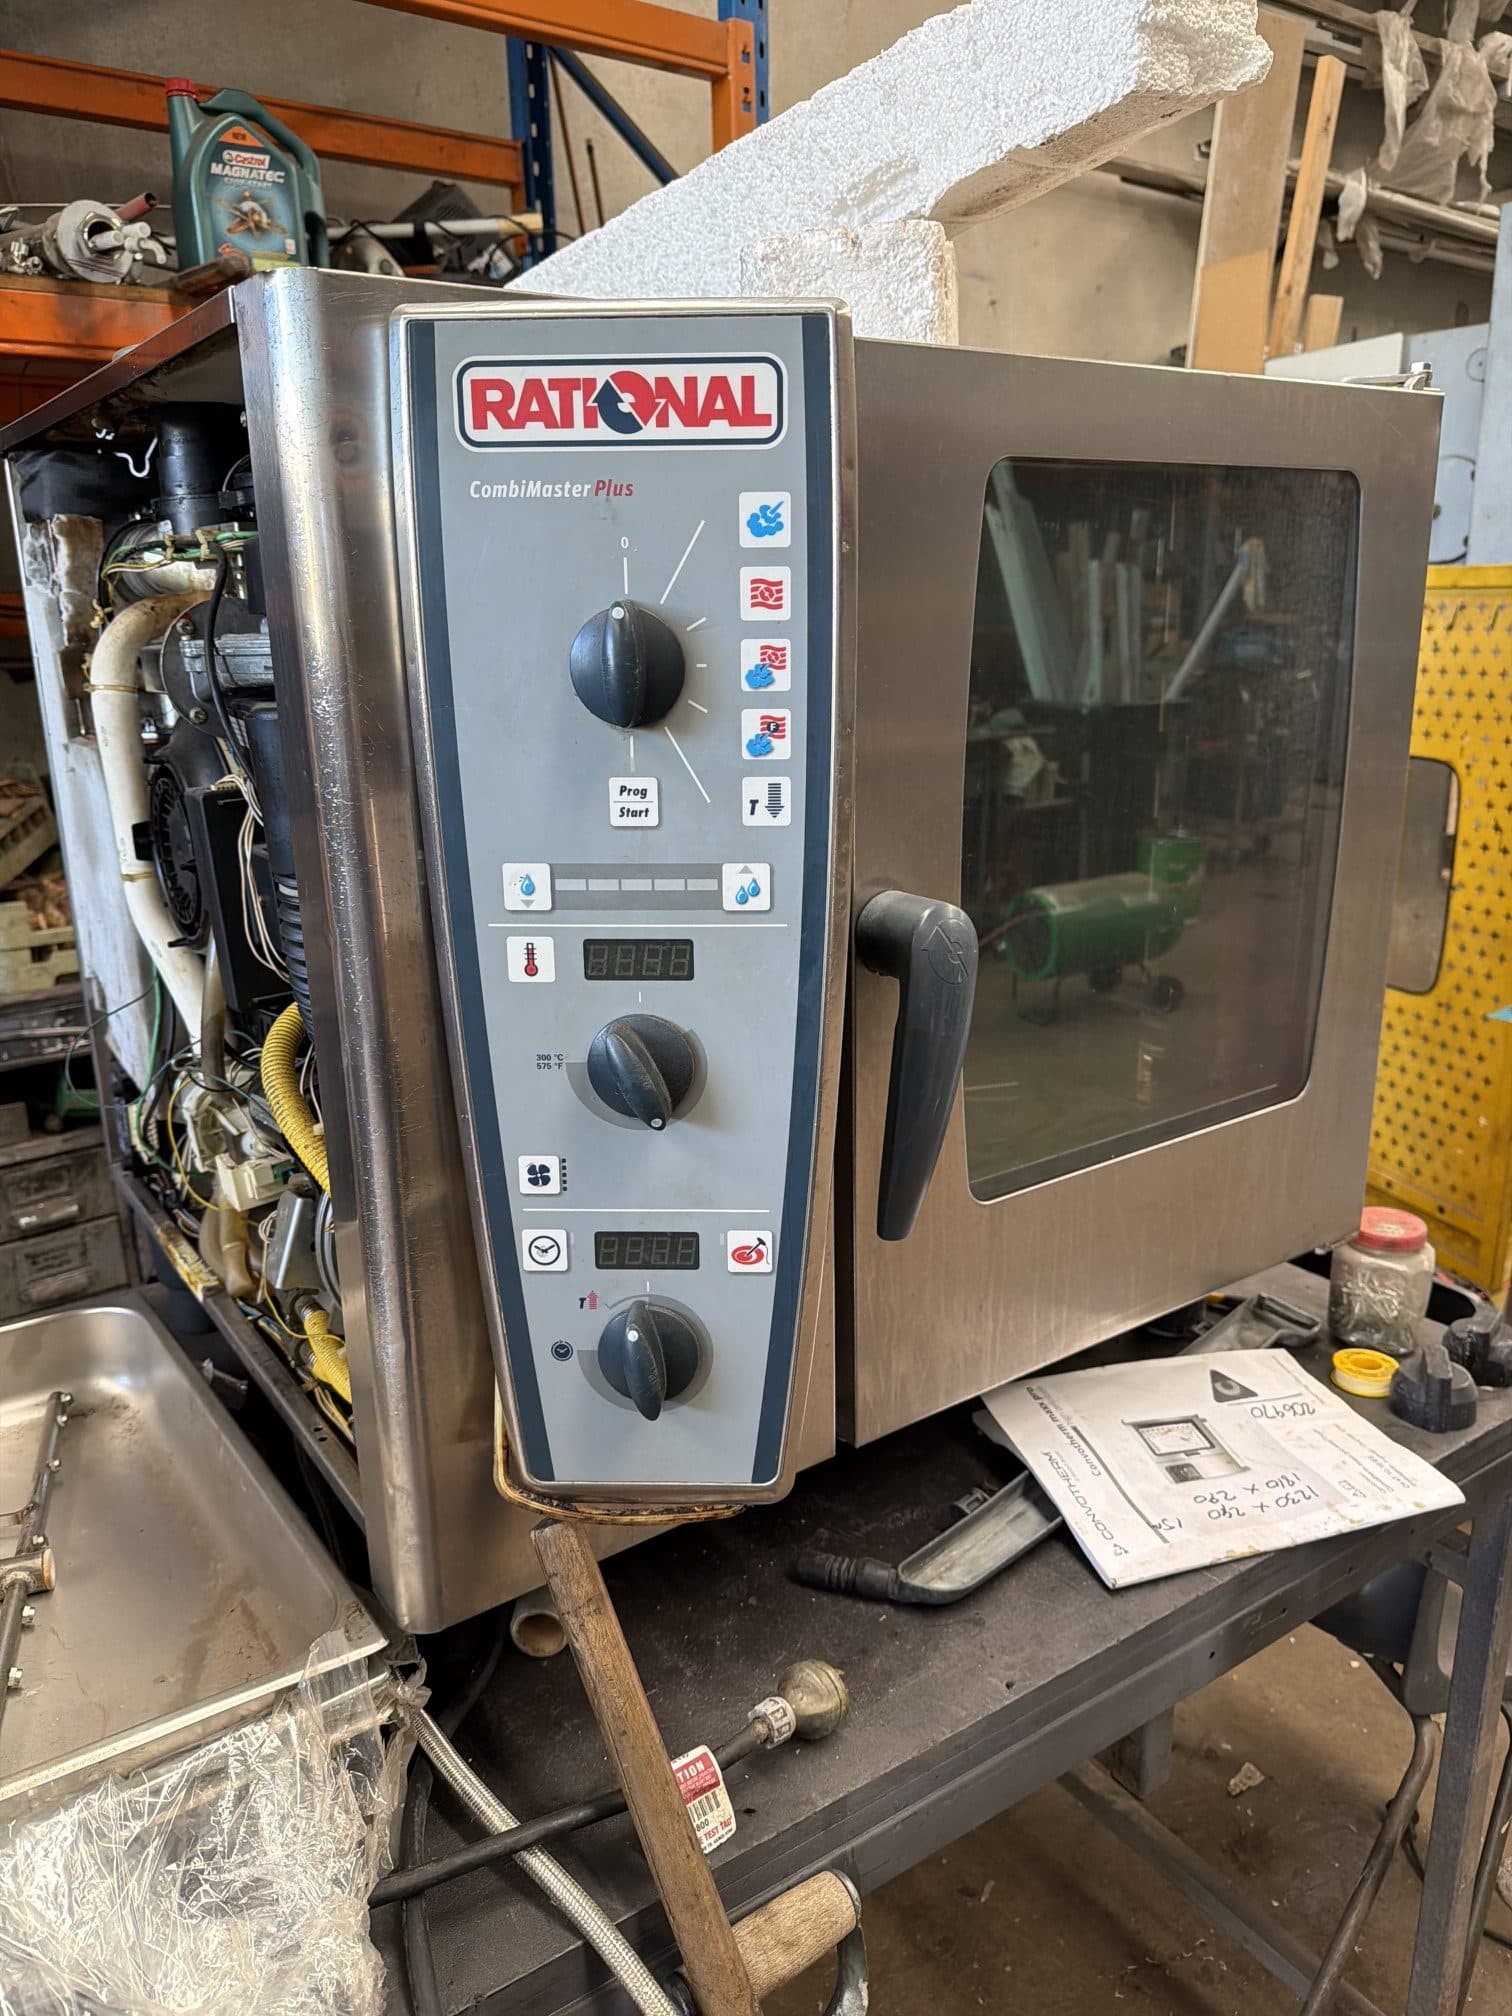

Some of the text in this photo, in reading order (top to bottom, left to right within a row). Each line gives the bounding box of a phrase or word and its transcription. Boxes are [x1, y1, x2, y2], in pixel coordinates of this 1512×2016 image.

[235, 154, 266, 167] Castrol
[210, 163, 285, 184] MAGNATEC
[470, 370, 772, 434] RATIONAL
[470, 479, 633, 498] CombiMaster Plus
[620, 537, 629, 549] 0
[619, 785, 648, 800] Prog
[618, 806, 649, 818] Start
[536, 1053, 552, 1061] 300
[536, 1062, 552, 1070] 575
[1057, 1422, 1101, 1477] Convotherm
[1042, 1450, 1114, 1541] CONVOTHERM
[1275, 1485, 1319, 1508] 1230
[676, 1759, 705, 1783] TION
